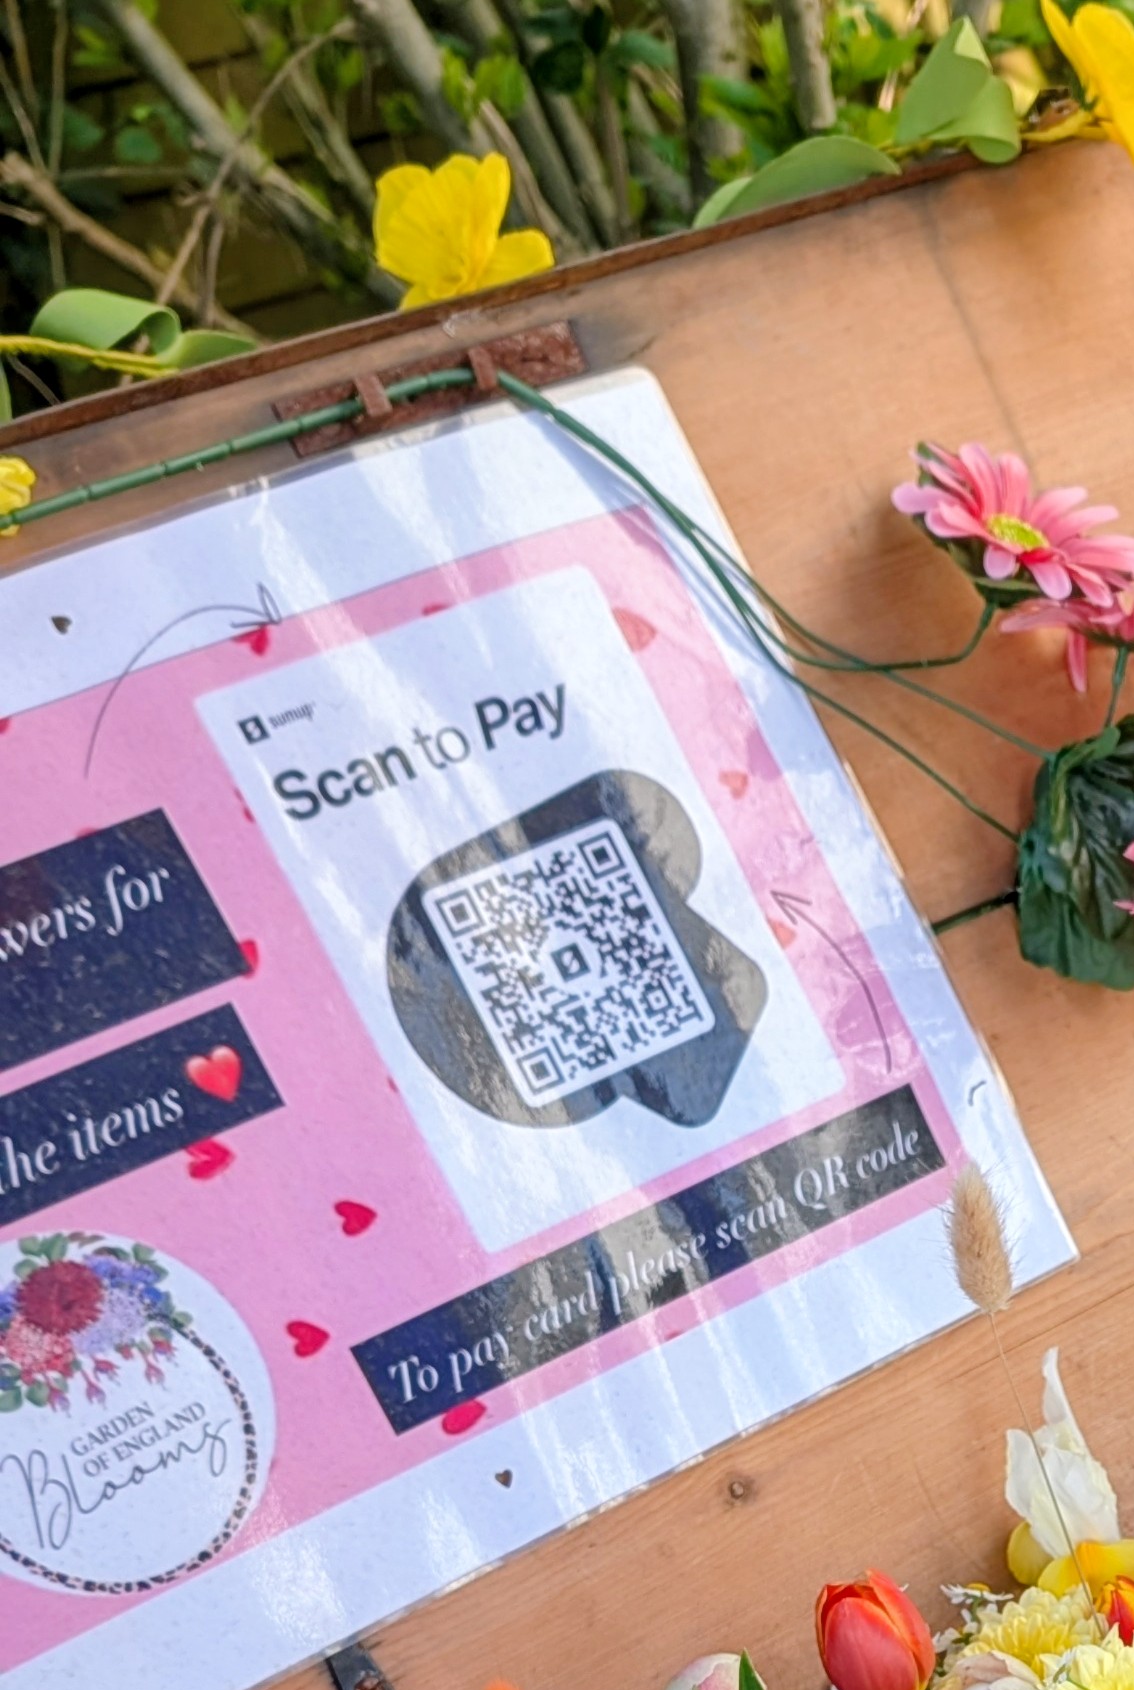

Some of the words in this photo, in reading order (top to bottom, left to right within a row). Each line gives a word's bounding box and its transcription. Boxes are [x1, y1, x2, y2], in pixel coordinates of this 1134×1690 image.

[273, 742, 414, 822] Scan
[413, 725, 471, 770] to
[475, 683, 567, 751] Pay
[105, 864, 170, 937] for
[0, 1136, 60, 1195] he
[67, 1088, 184, 1161] items
[388, 1356, 440, 1406] To
[450, 1330, 512, 1393] pay
[523, 1271, 599, 1342] card
[609, 1233, 709, 1316] please
[715, 1197, 787, 1250] scan
[793, 1156, 849, 1211] QR
[856, 1122, 921, 1180] code
[70, 1401, 156, 1457] GARDEN
[82, 1452, 111, 1478] OF
[112, 1402, 207, 1462] ENGLAND
[0, 1419, 232, 1550] Blooms
